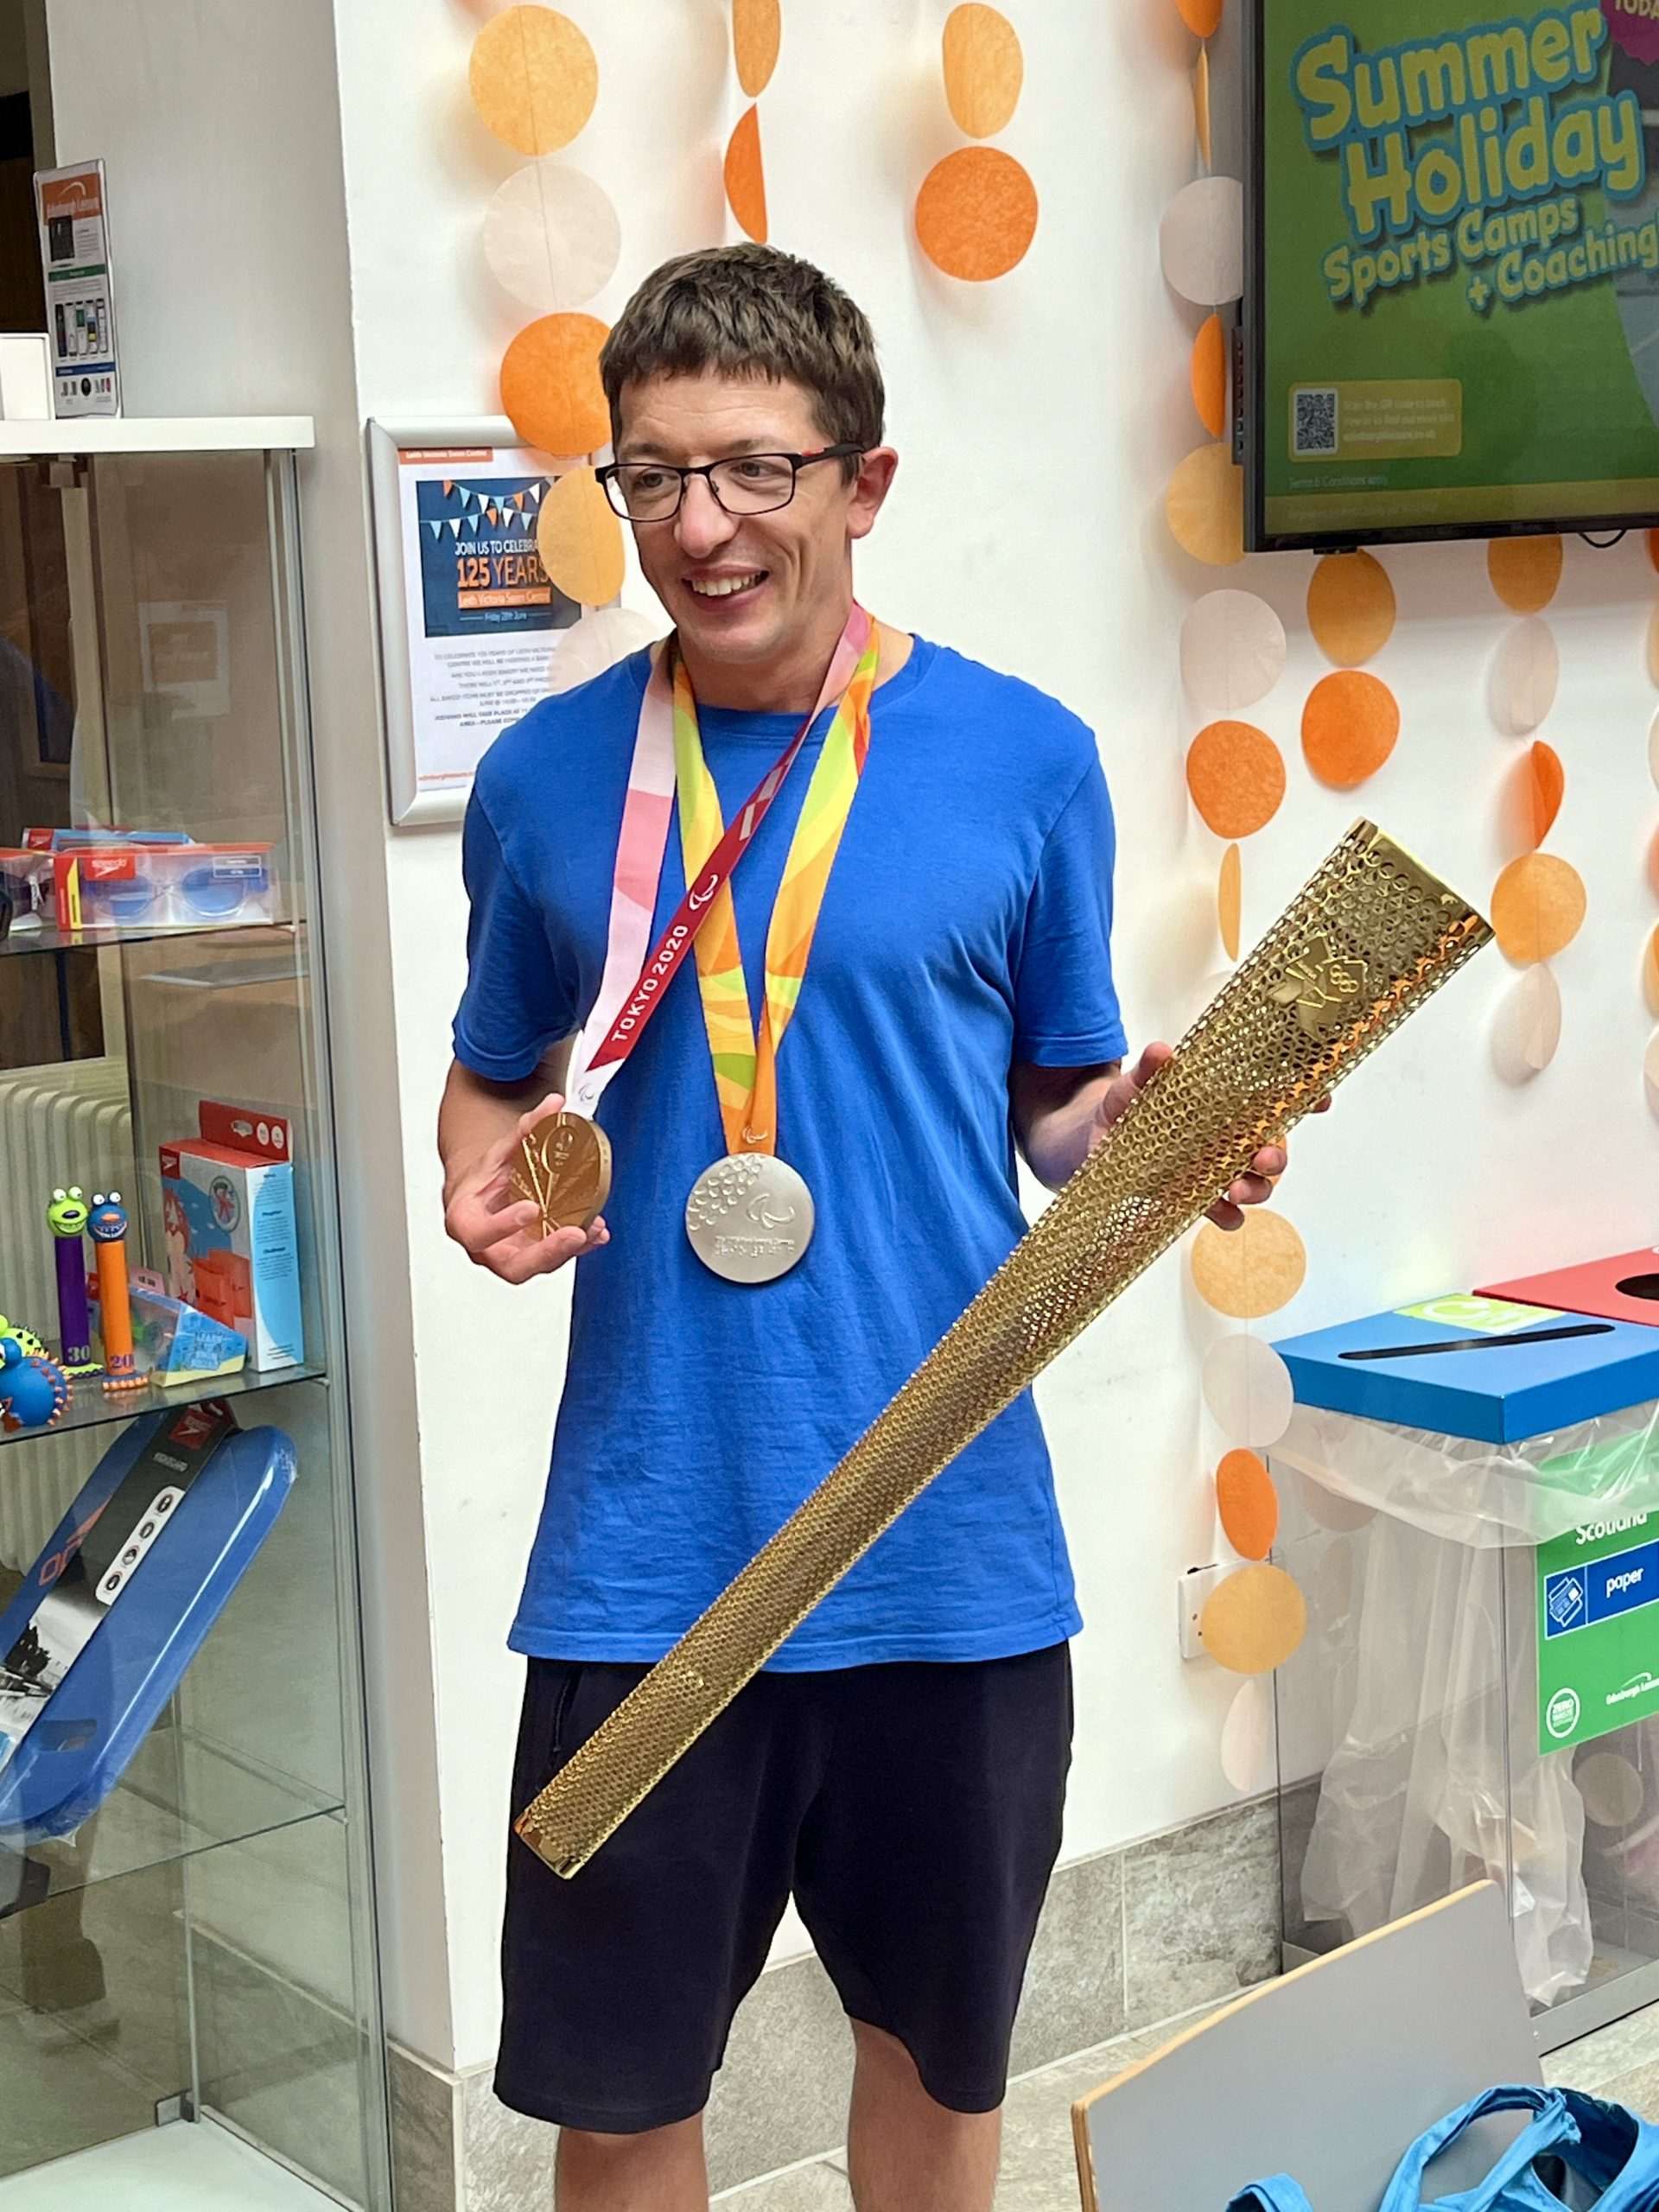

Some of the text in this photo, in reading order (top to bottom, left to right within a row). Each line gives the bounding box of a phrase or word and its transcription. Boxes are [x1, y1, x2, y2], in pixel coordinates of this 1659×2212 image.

[1294, 6, 1605, 143] Summer
[1344, 94, 1642, 235] Holiday
[1323, 198, 1579, 307] Sports Camps
[1468, 222, 1658, 307] + Coaching
[454, 541, 476, 556] JOIN
[477, 541, 489, 555] US
[490, 540, 503, 554] TO
[457, 557, 491, 588] 125
[611, 925, 689, 1042] TOKYO 2020
[67, 1345, 91, 1363] 30
[1605, 1567, 1644, 1599] paper
